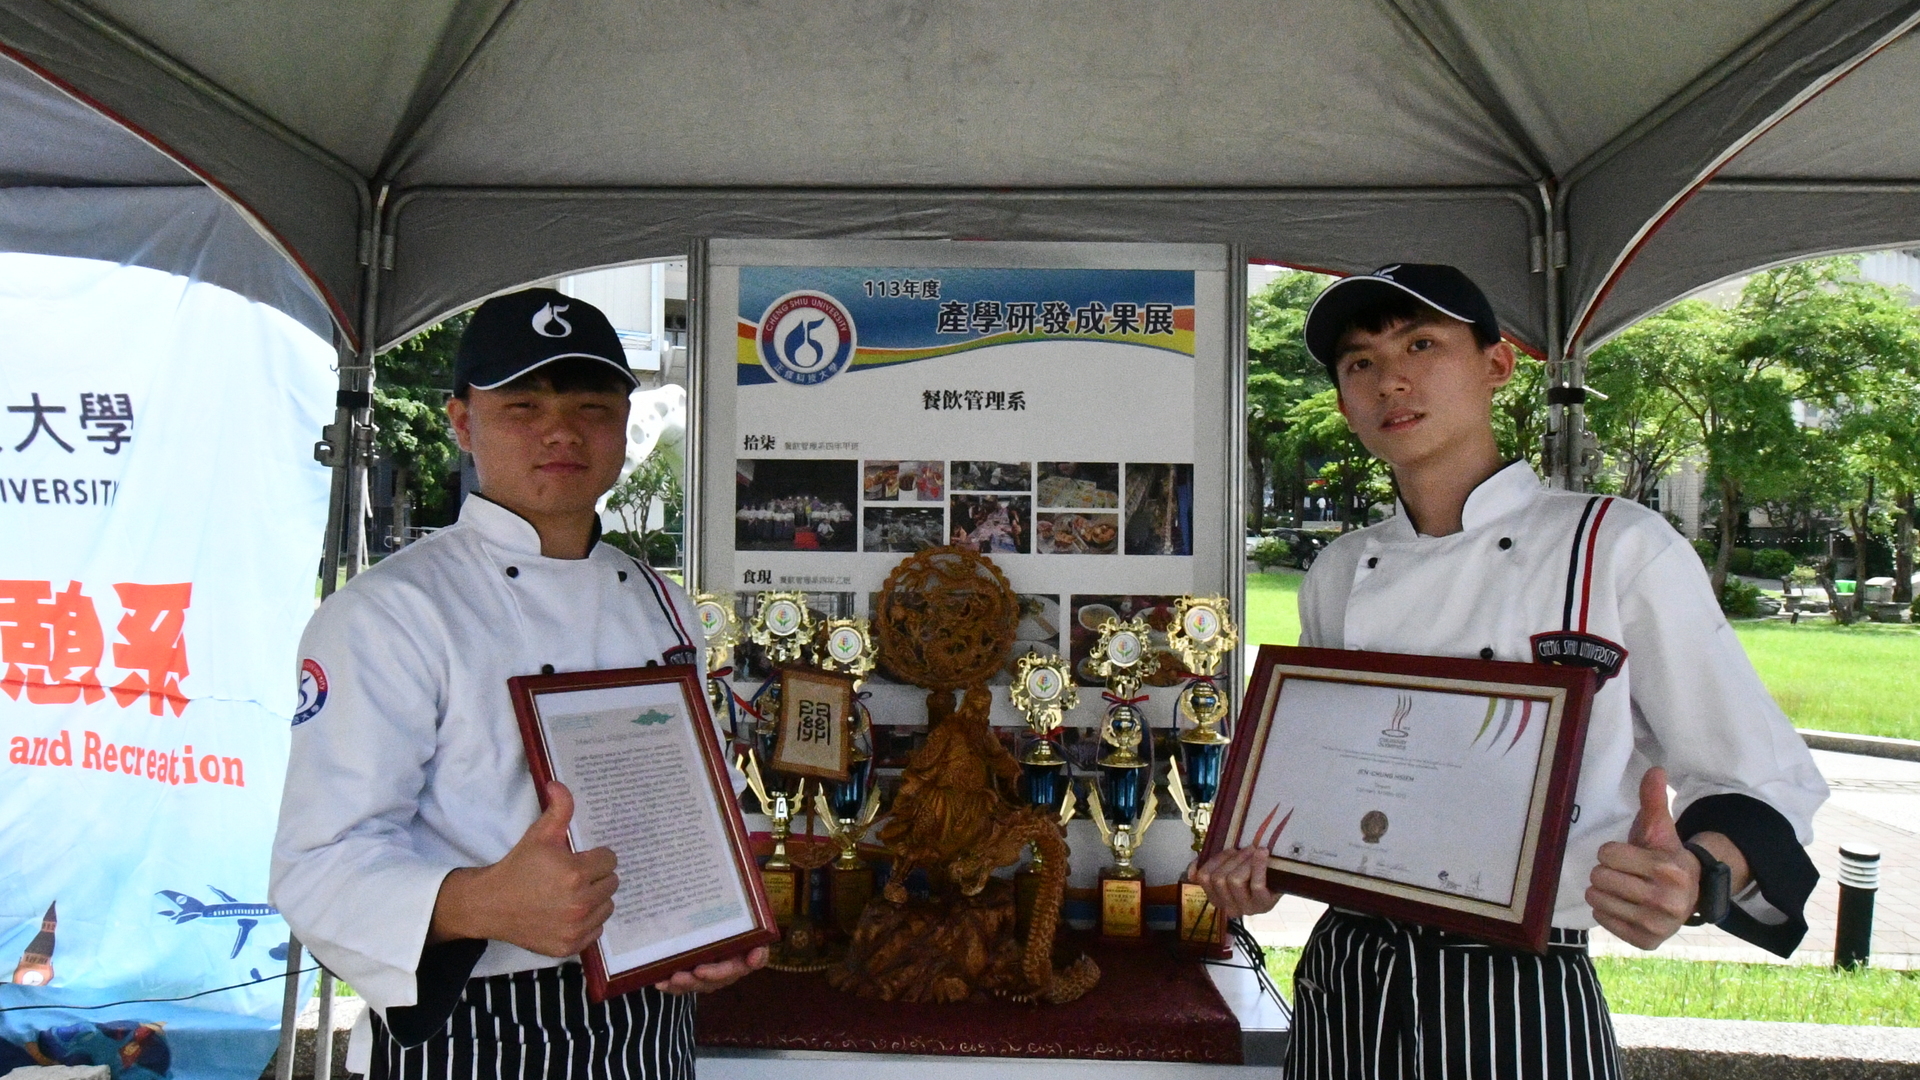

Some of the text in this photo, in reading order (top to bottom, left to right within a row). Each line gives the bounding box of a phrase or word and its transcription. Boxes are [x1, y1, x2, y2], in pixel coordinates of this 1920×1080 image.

[863, 279, 940, 298] 113年度
[766, 297, 847, 332] CHENG SHIU UNIVERSITY
[937, 301, 1174, 335] 產學研發成果展
[922, 390, 1026, 411] 餐飲管理系
[0, 392, 134, 455] 大學
[744, 435, 775, 450] 拾柒
[743, 569, 772, 584] 食現
[9, 730, 245, 787] and Recreation
